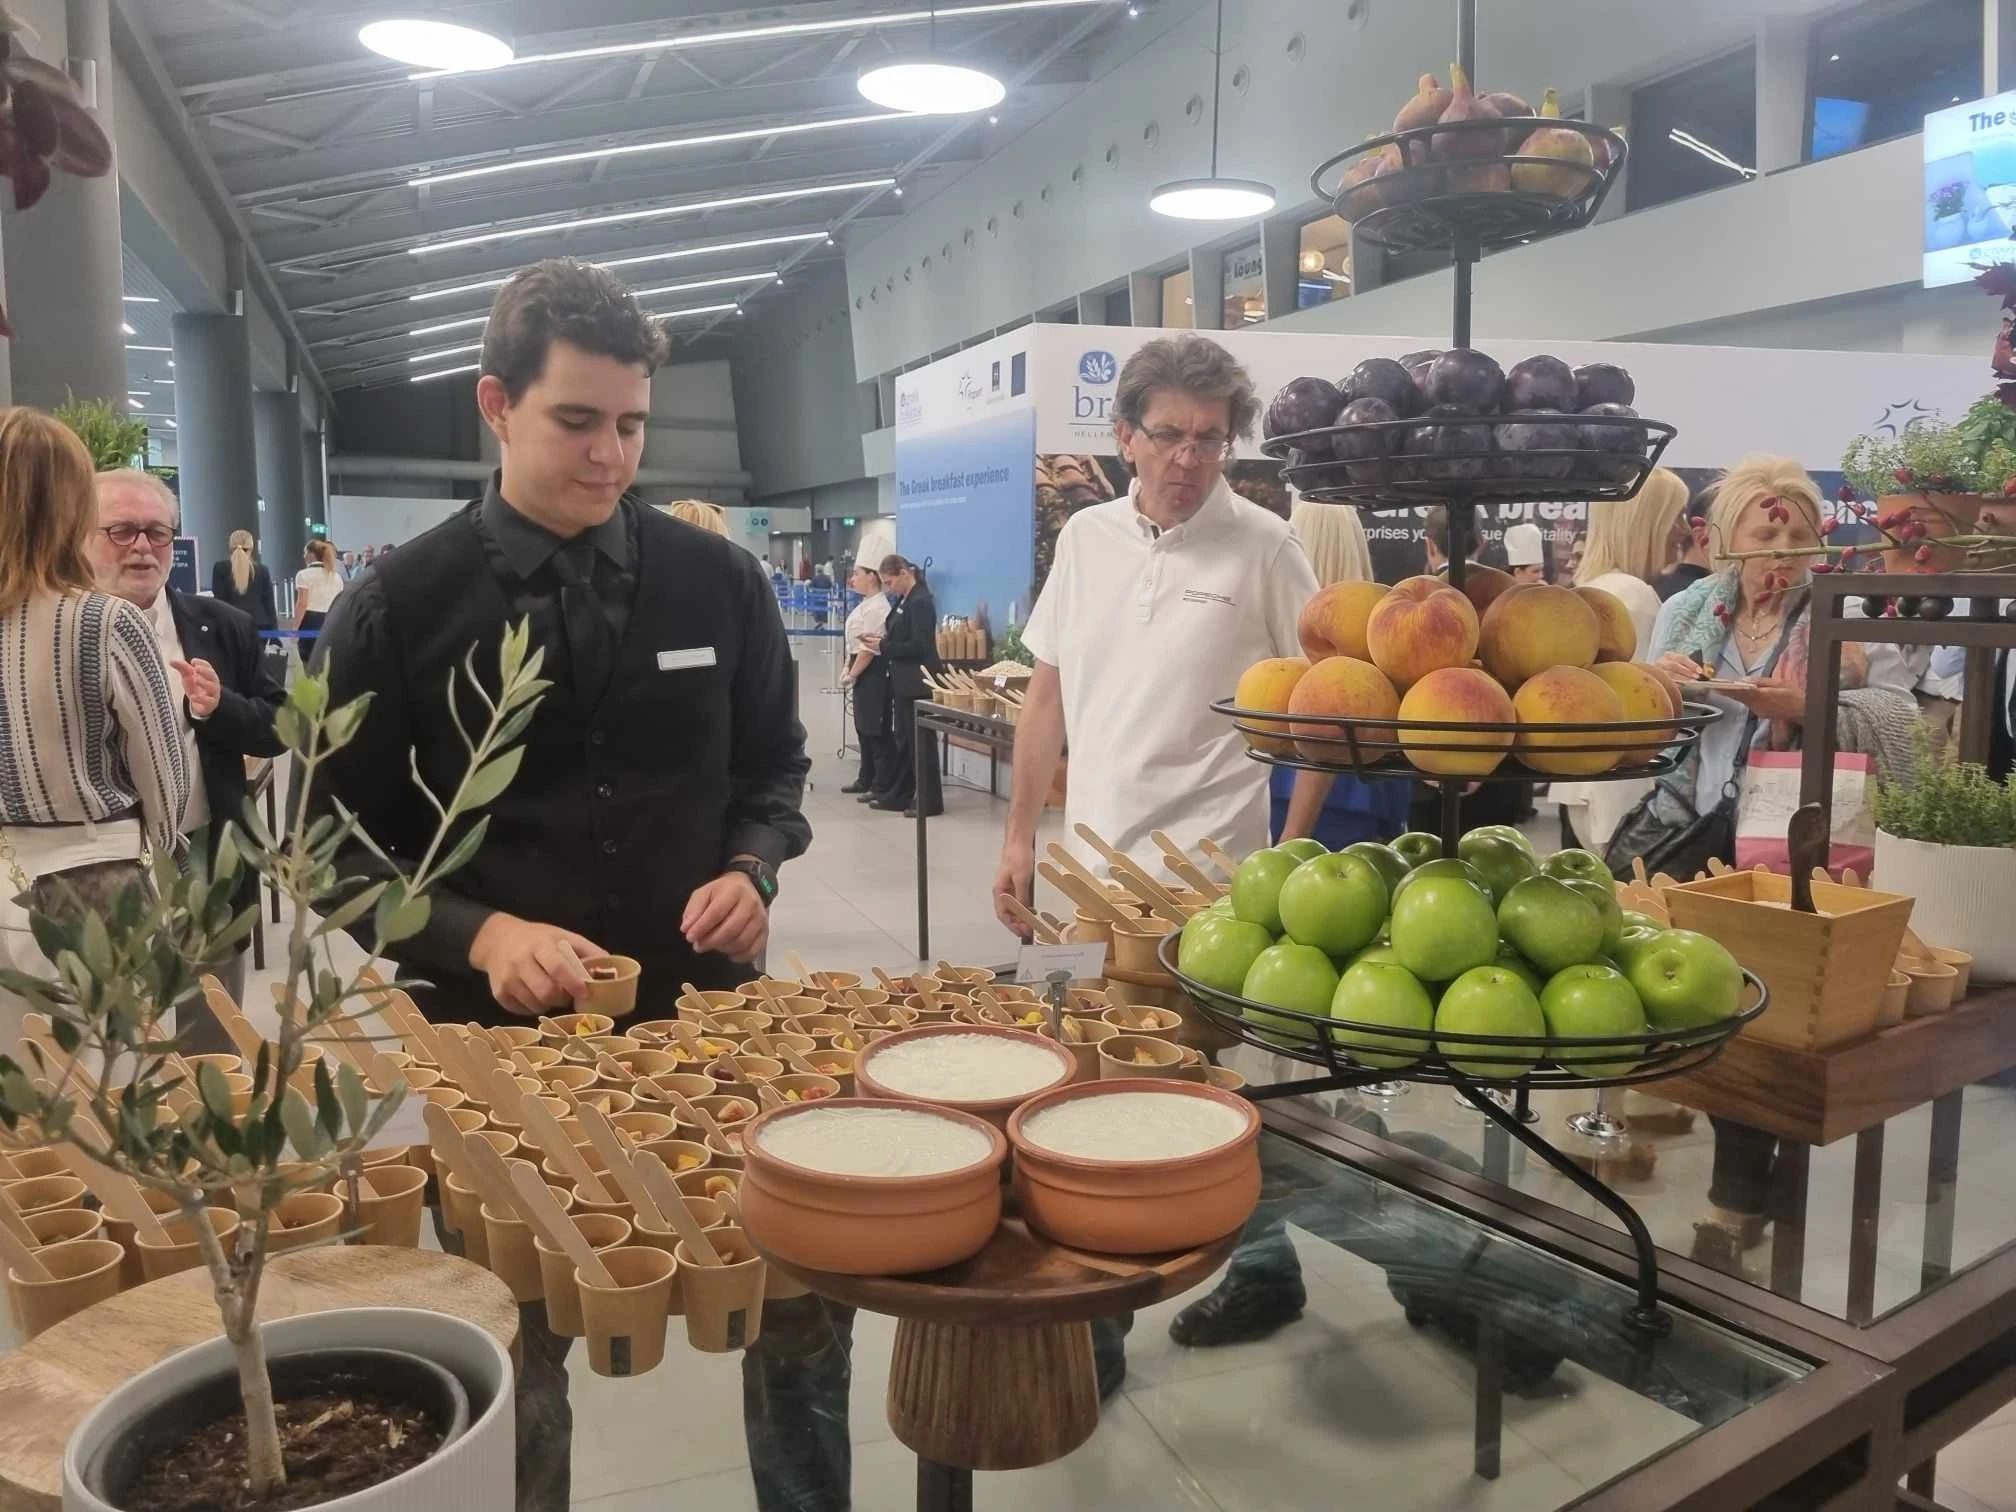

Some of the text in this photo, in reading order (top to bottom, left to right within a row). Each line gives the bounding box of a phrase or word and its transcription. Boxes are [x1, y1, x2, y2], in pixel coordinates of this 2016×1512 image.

[1969, 111, 2006, 132] The
[931, 471, 964, 492] breakfast
[966, 465, 1010, 488] experience
